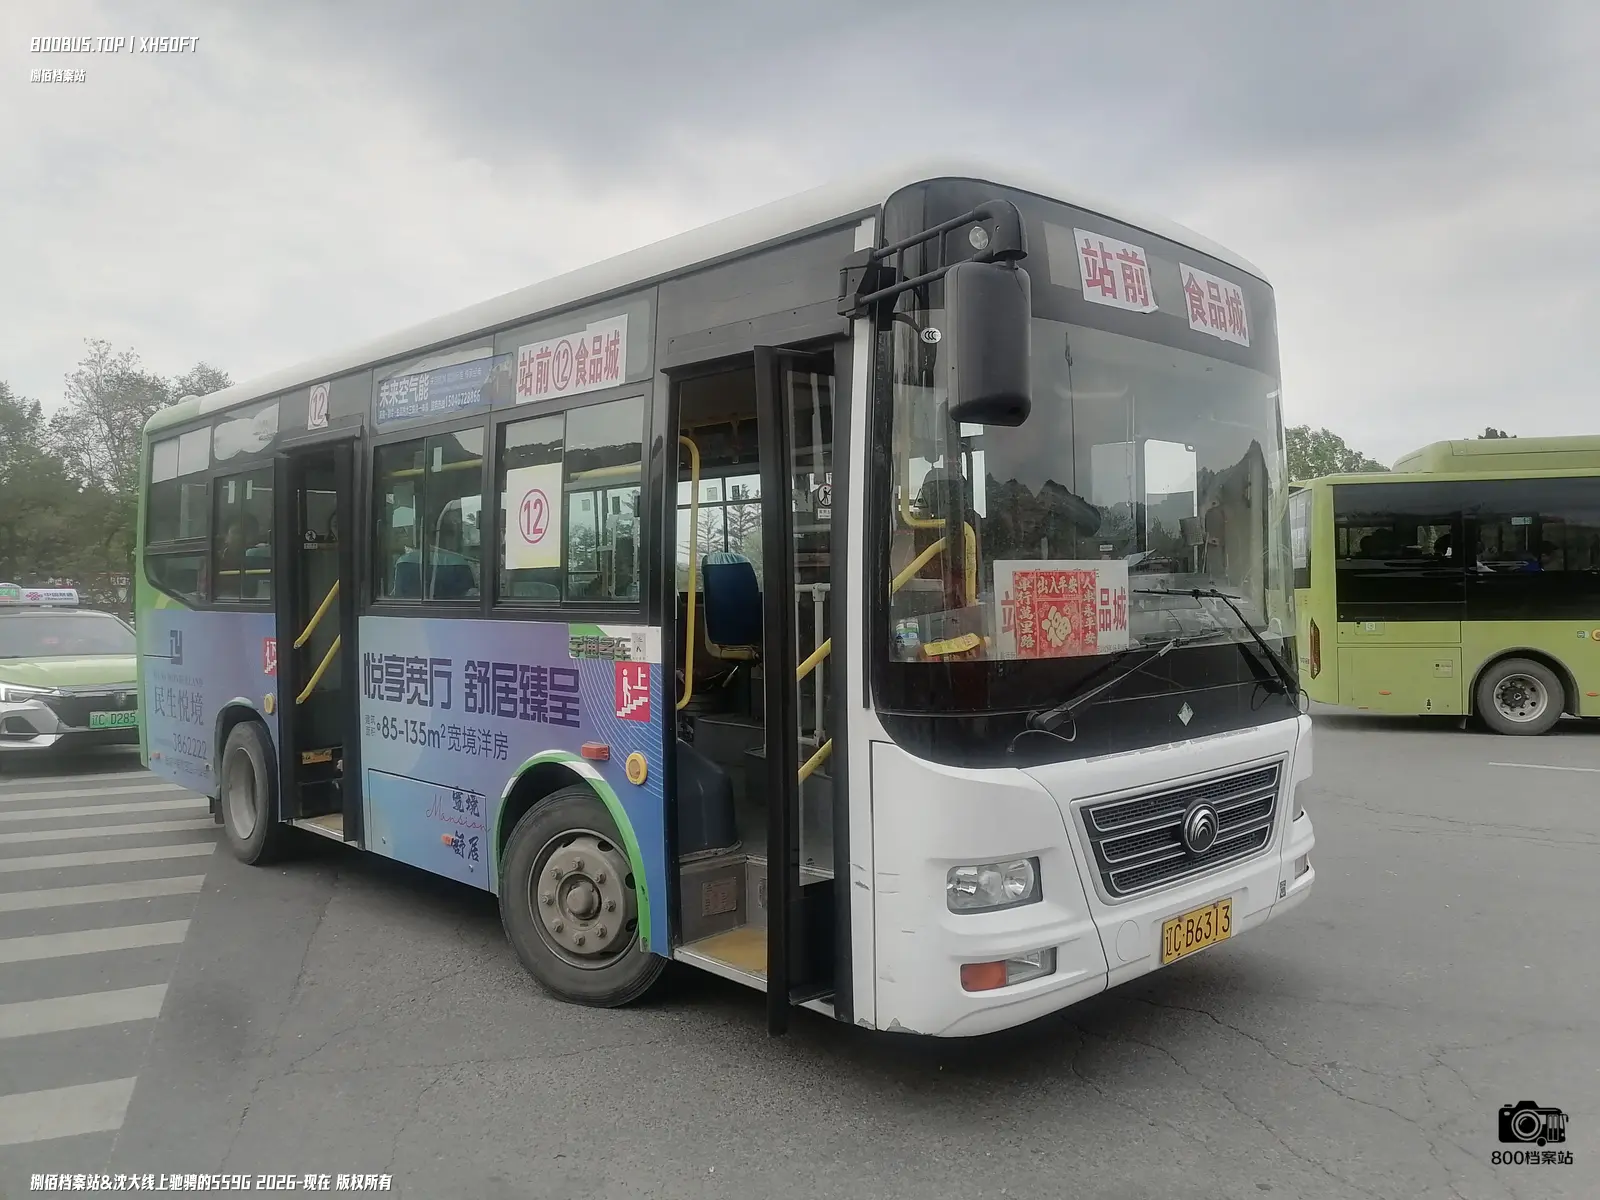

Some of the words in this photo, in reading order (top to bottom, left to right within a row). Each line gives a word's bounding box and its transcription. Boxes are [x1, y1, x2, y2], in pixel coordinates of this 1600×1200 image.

[1080, 237, 1150, 307] 站前
[1182, 271, 1248, 341] 食品城
[1037, 576, 1079, 595] 出入平安
[1041, 605, 1073, 648] 福
[363, 652, 453, 710] 悦享宽厅
[464, 660, 581, 728] 舒居臻呈
[632, 666, 648, 690] 上
[110, 712, 138, 725] D285
[154, 686, 204, 726] 民生悦境
[426, 793, 491, 833] Mansion
